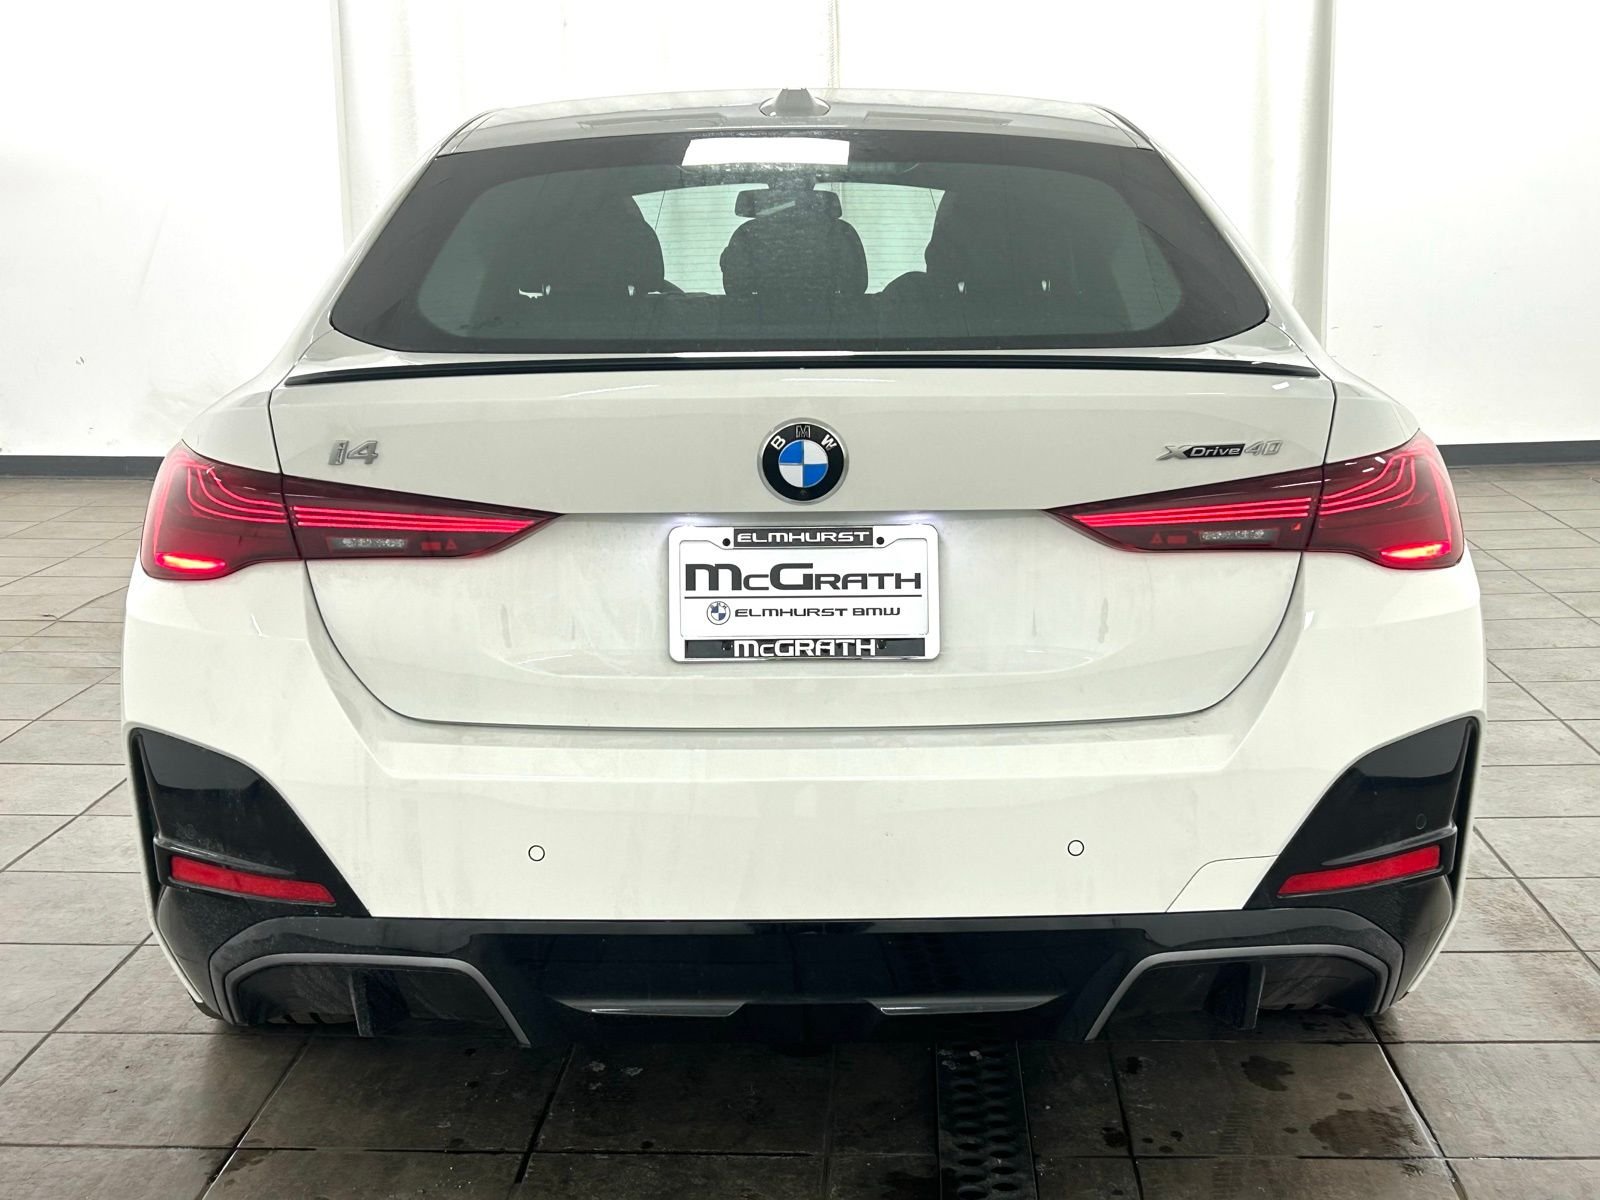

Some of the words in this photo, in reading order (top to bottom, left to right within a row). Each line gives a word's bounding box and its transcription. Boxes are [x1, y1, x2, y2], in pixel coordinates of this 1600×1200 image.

[770, 425, 837, 451] BMW
[328, 440, 379, 465] i4
[737, 531, 869, 543] ELMHURST
[735, 607, 848, 617] ELMHURST
[852, 607, 900, 617] BMW
